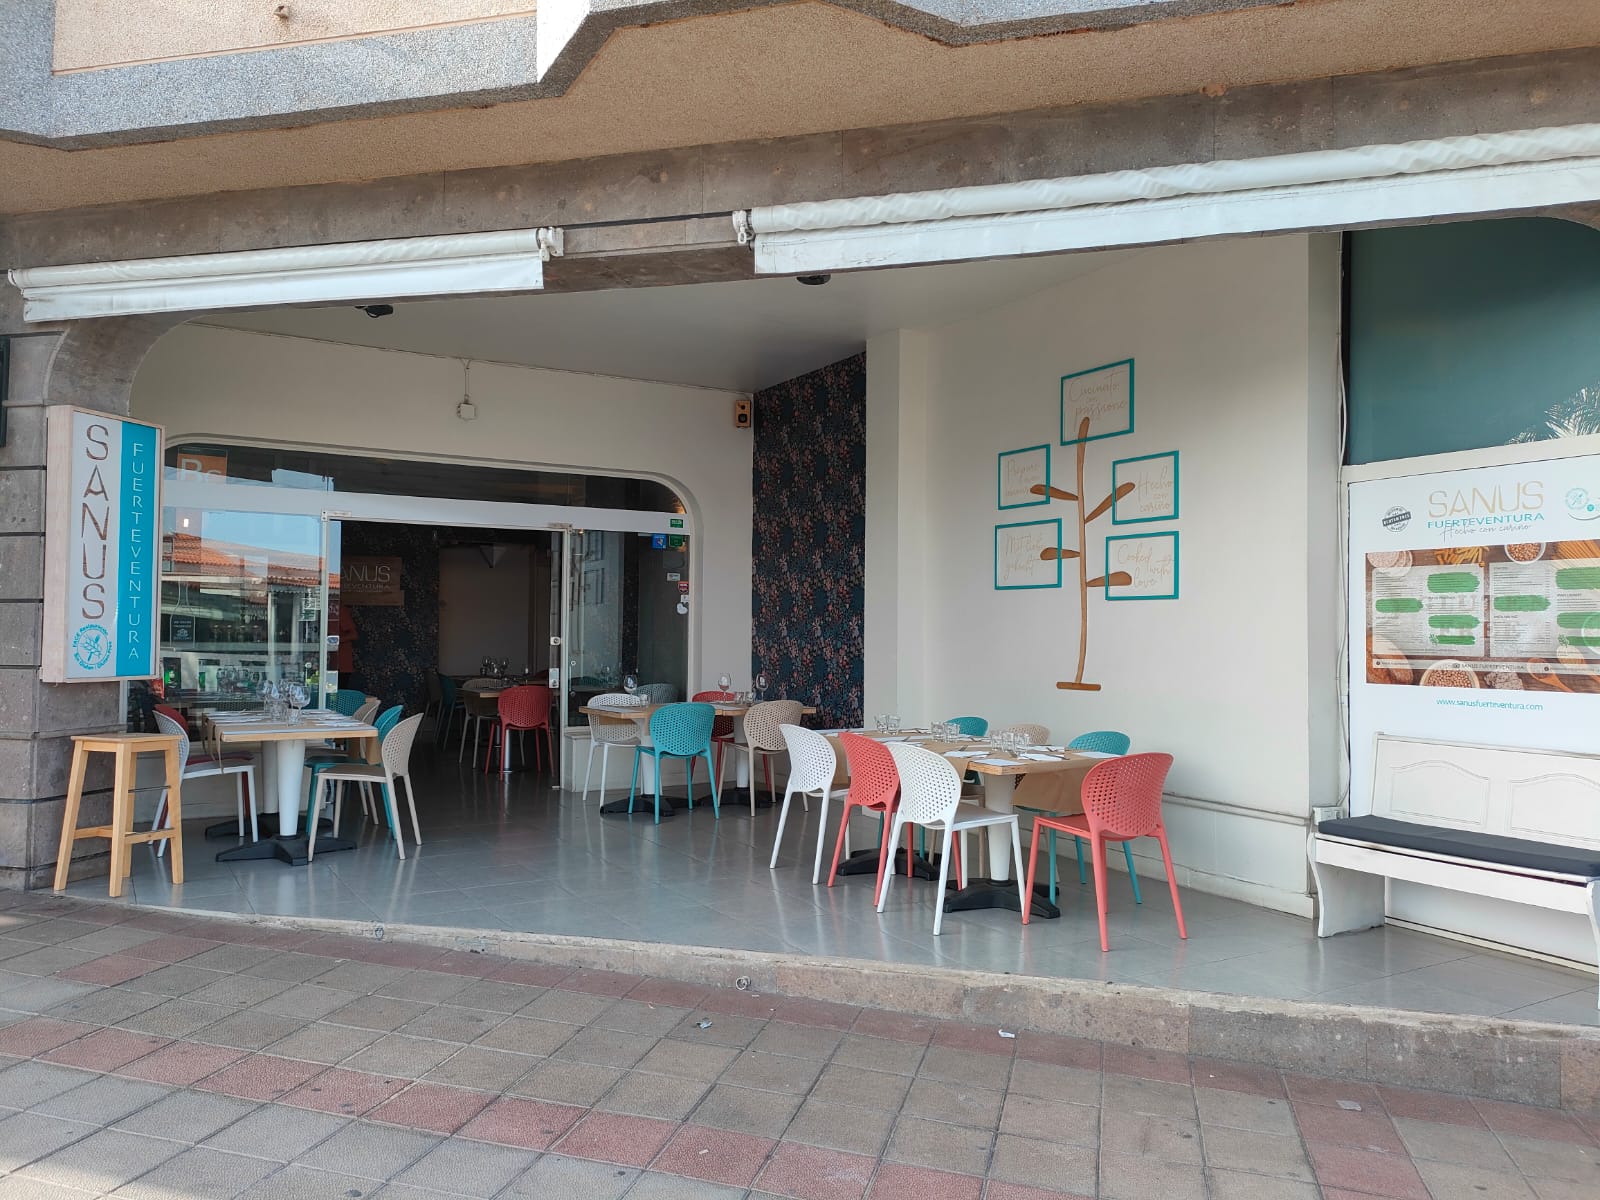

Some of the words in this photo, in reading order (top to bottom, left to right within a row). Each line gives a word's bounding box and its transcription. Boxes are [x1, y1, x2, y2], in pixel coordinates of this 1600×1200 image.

[1428, 480, 1544, 519] SANUS
[81, 423, 110, 620] SANUS
[1427, 512, 1544, 529] FUERTEVENTURA
[128, 442, 144, 660] FUERTEVENTURA
[341, 564, 392, 583] ANUS
[1435, 698, 1543, 712] www.sanusfuerteventura.com
